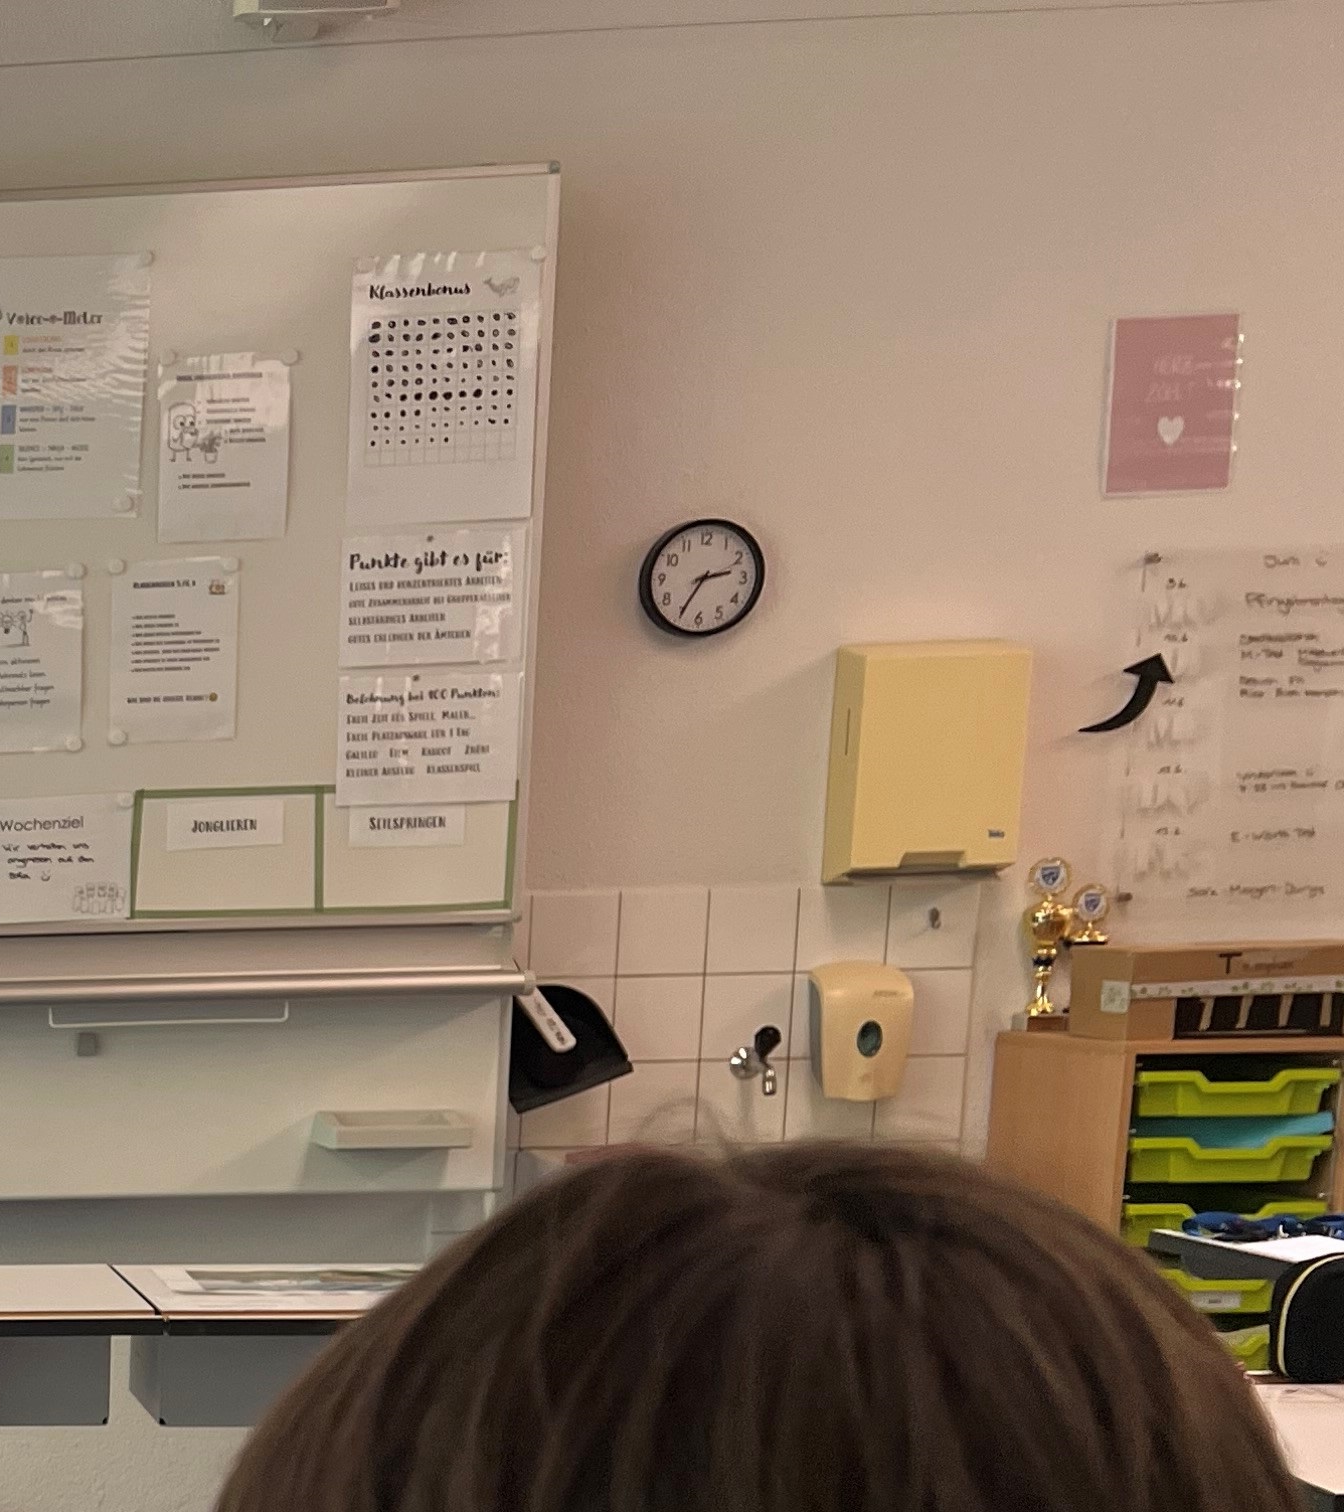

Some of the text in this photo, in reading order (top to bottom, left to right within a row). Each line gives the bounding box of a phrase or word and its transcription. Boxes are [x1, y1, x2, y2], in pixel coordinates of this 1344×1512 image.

[350, 553, 408, 570] Punkte
[414, 550, 448, 574] gibt
[453, 553, 469, 566] es
[0, 816, 84, 832] Wochenziel
